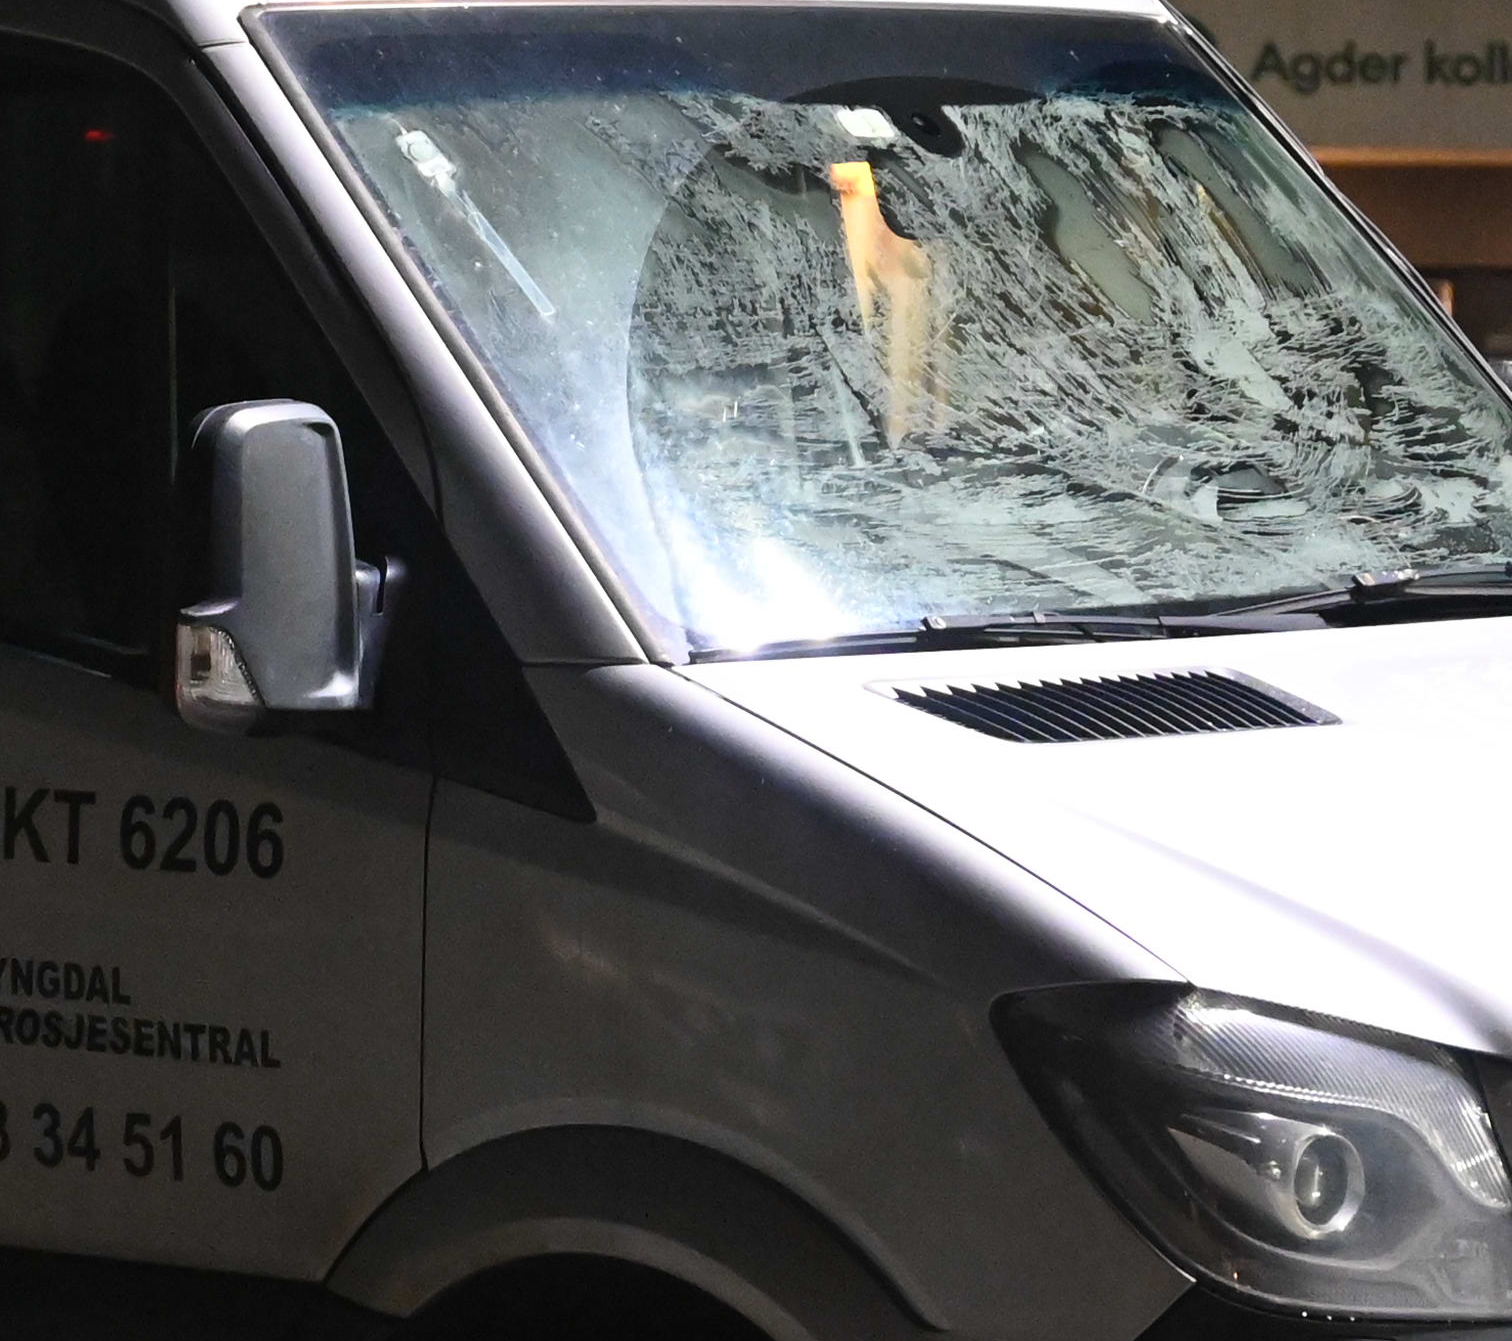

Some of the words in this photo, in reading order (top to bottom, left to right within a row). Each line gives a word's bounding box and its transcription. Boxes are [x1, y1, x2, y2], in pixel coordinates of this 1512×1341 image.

[1251, 41, 1406, 96] Agder
[2, 785, 96, 865] KT
[119, 794, 284, 880] 6206
[32, 1102, 102, 1173] 34
[122, 1112, 184, 1182] 51
[212, 1121, 285, 1192] 60
